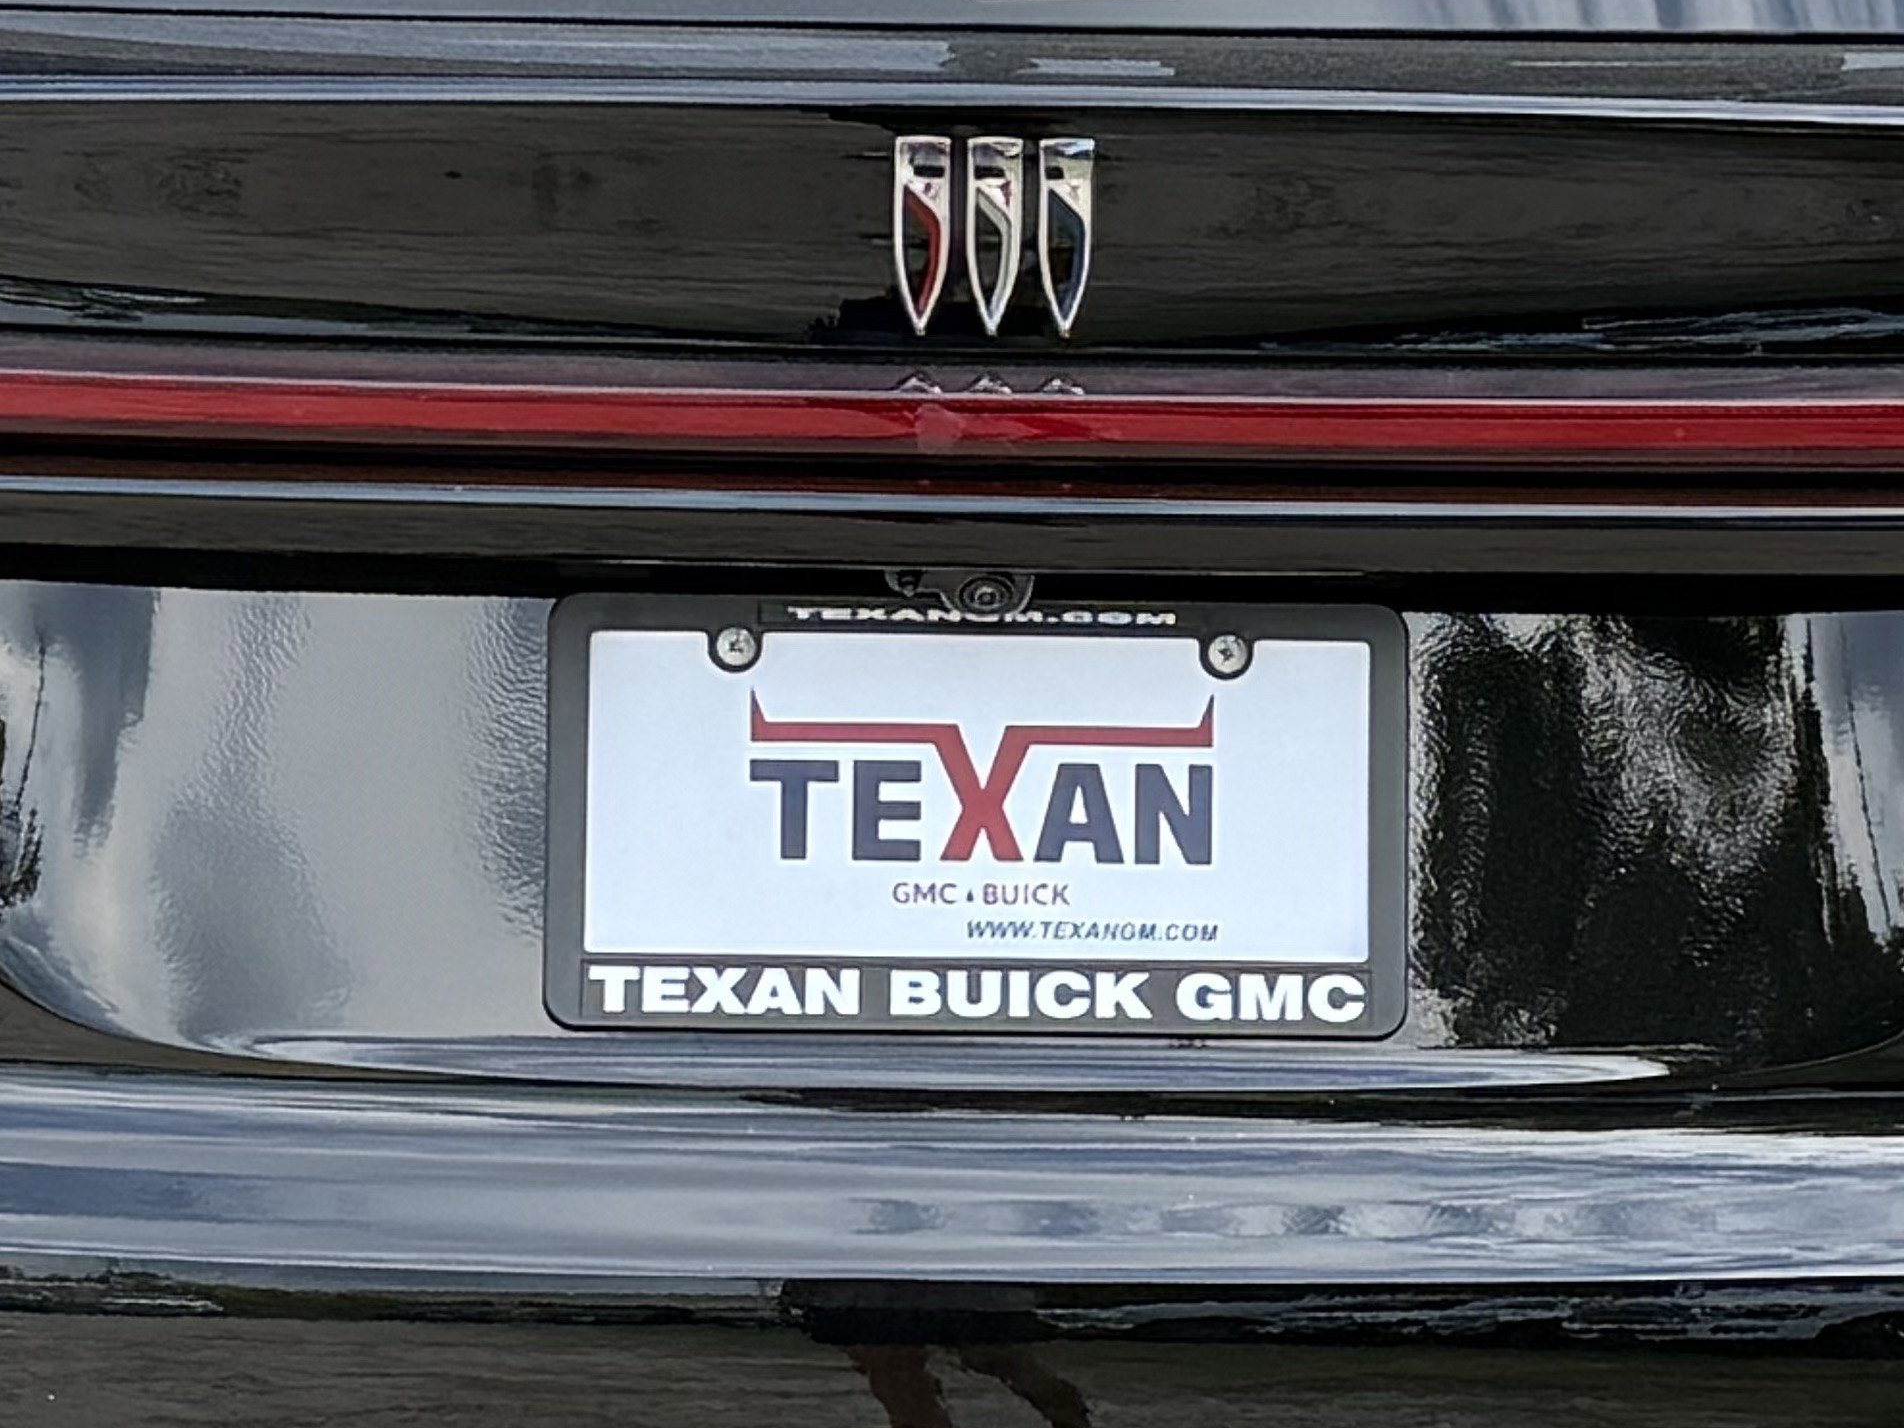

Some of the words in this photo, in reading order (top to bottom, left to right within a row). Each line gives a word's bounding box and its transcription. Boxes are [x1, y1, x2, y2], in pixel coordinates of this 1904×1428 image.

[749, 722, 1214, 866] TEXAN
[891, 882, 959, 906] GMC
[981, 882, 1071, 906] BUICK
[588, 964, 861, 1018] TEXAN
[889, 969, 1154, 1022] BUICK
[1175, 971, 1367, 1024] GMC
